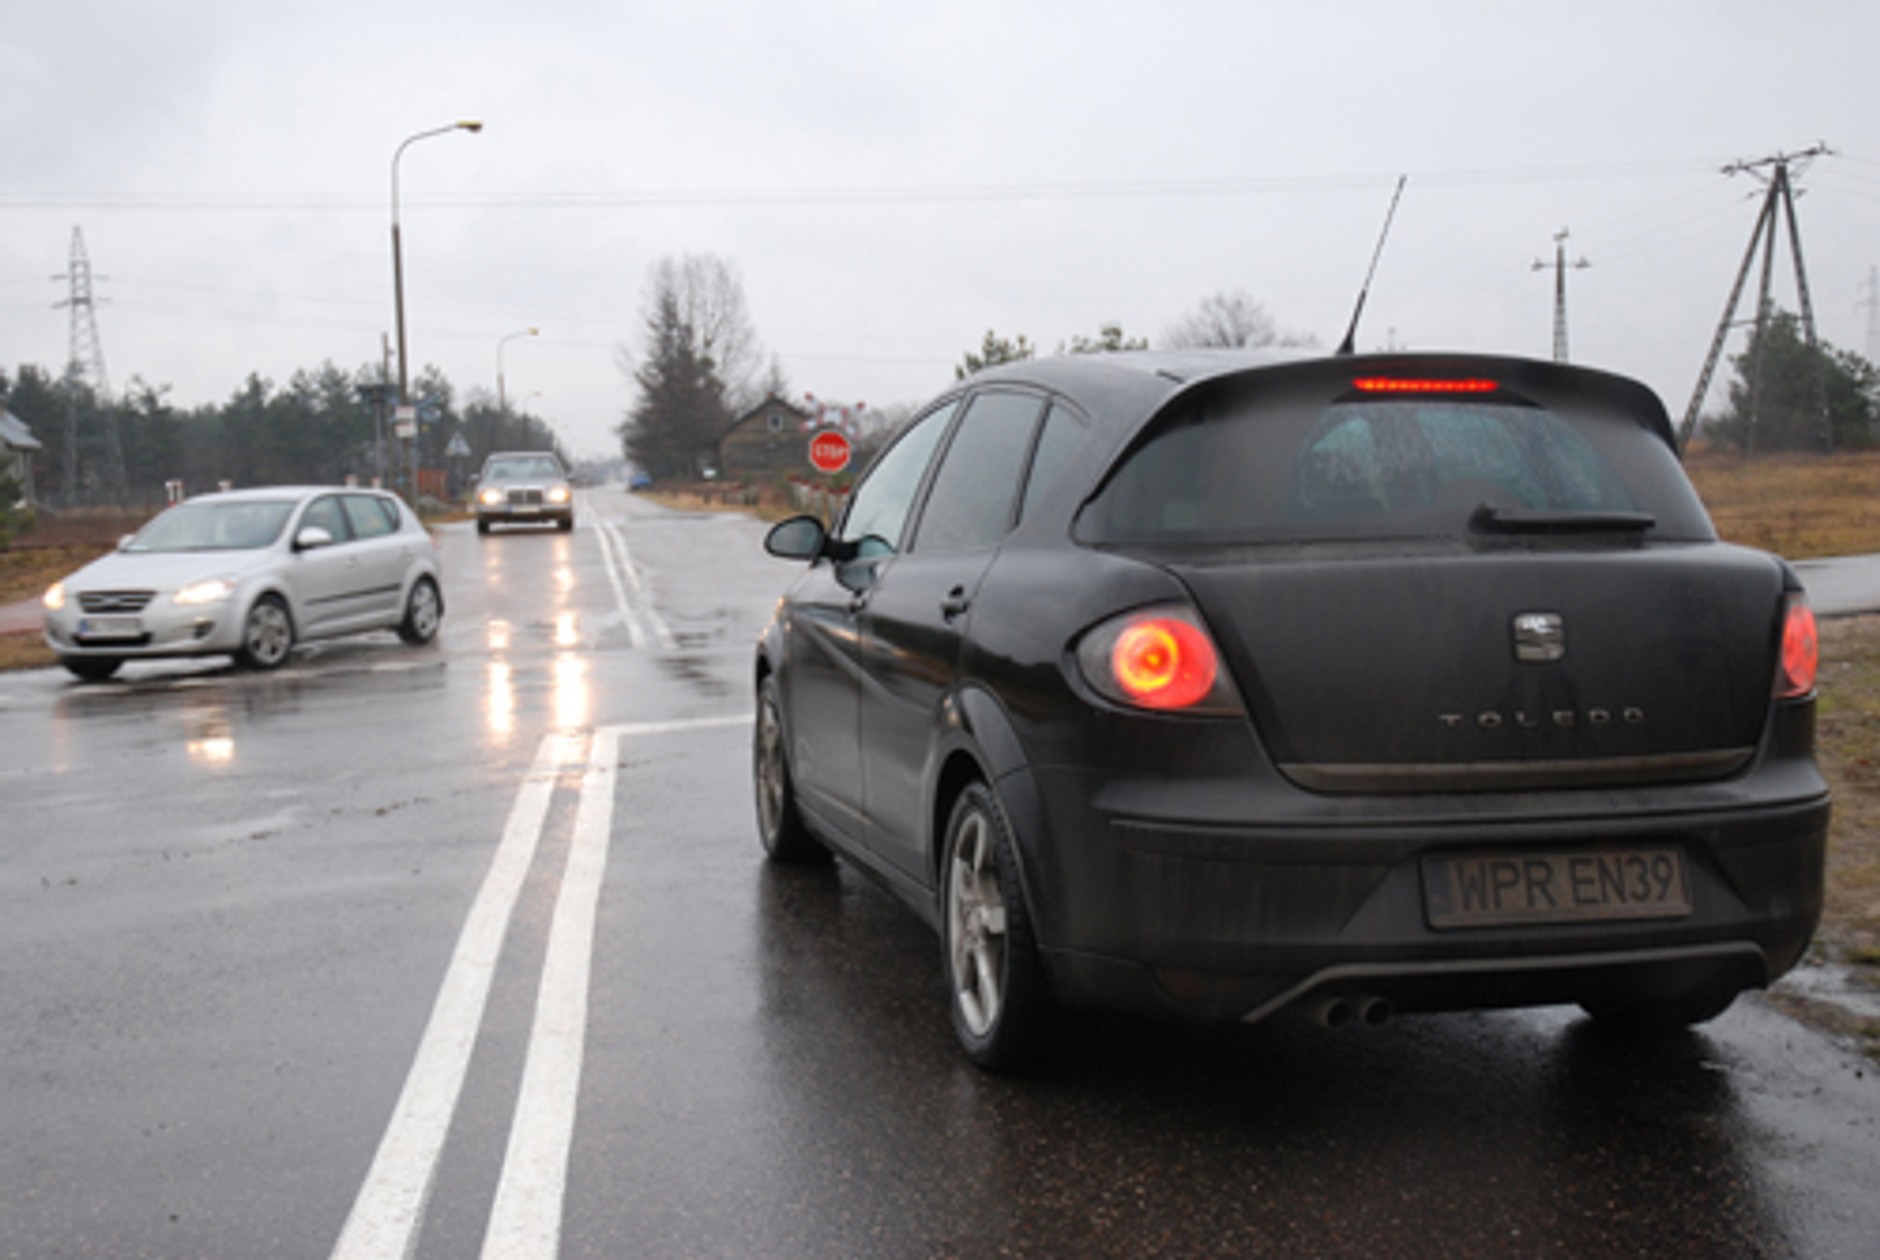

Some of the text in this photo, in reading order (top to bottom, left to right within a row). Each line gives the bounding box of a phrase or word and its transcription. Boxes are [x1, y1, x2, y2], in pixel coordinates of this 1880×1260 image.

[815, 444, 846, 460] STOP
[1438, 706, 1644, 727] TOLEDO
[1455, 853, 1675, 912] WPR EN39
